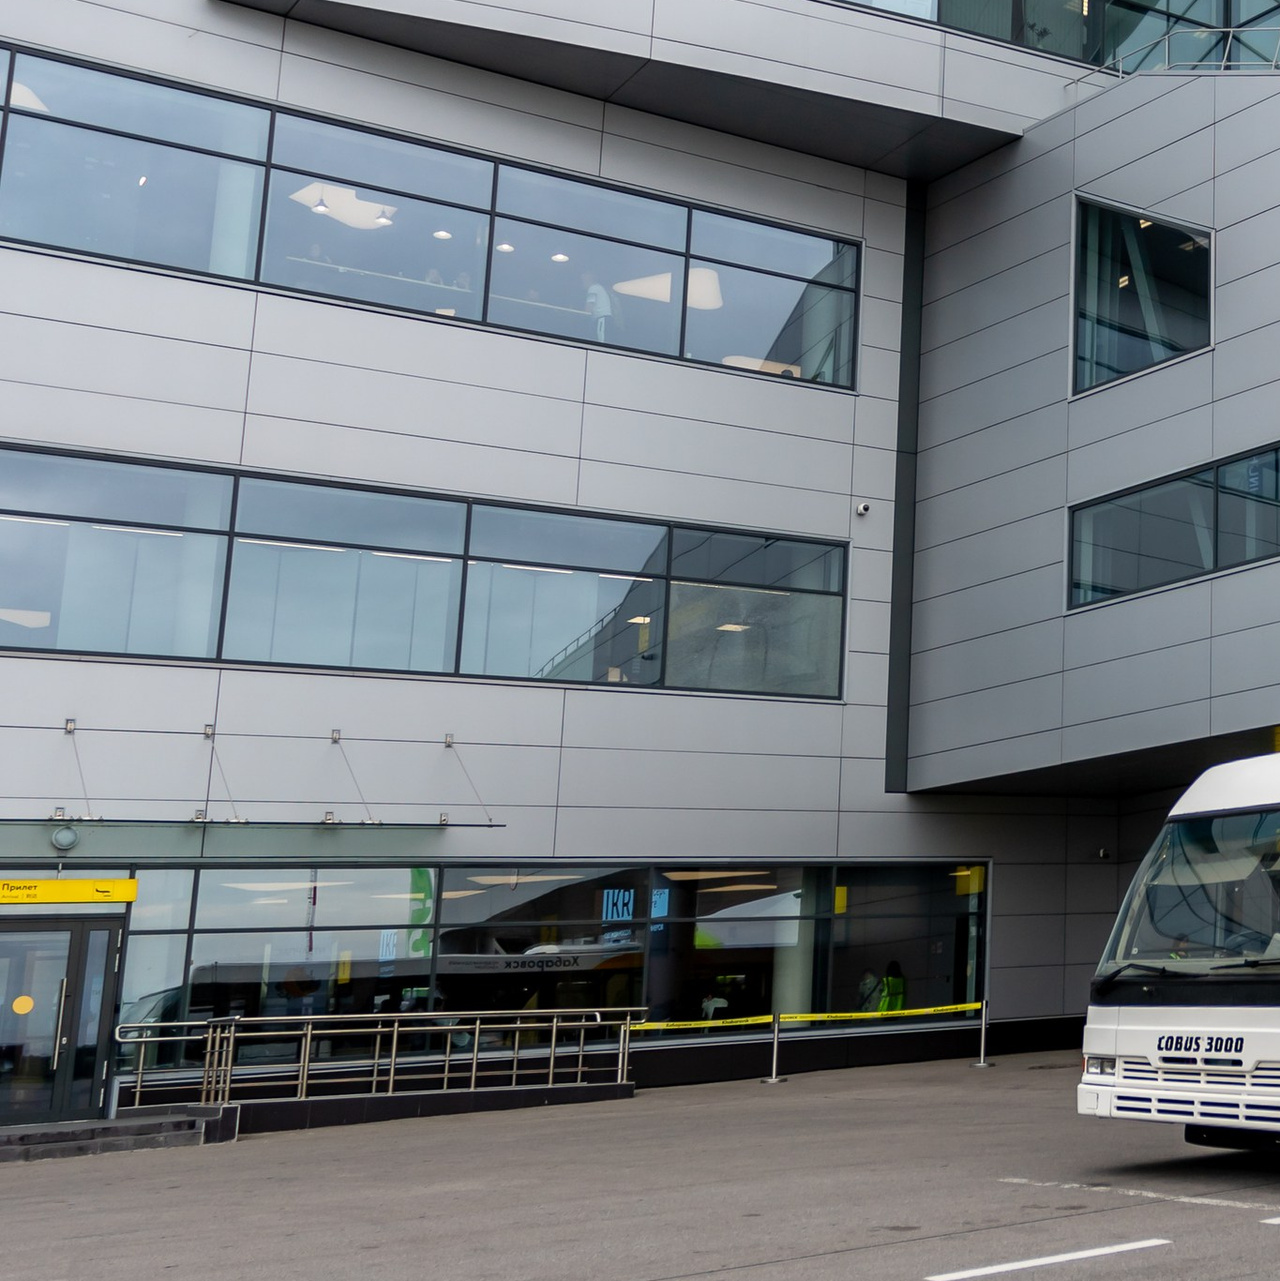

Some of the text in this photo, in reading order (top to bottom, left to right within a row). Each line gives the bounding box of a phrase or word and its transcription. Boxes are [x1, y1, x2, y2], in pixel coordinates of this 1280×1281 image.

[2, 883, 38, 892] Прилет
[1157, 1035, 1244, 1053] COBUS 3000
